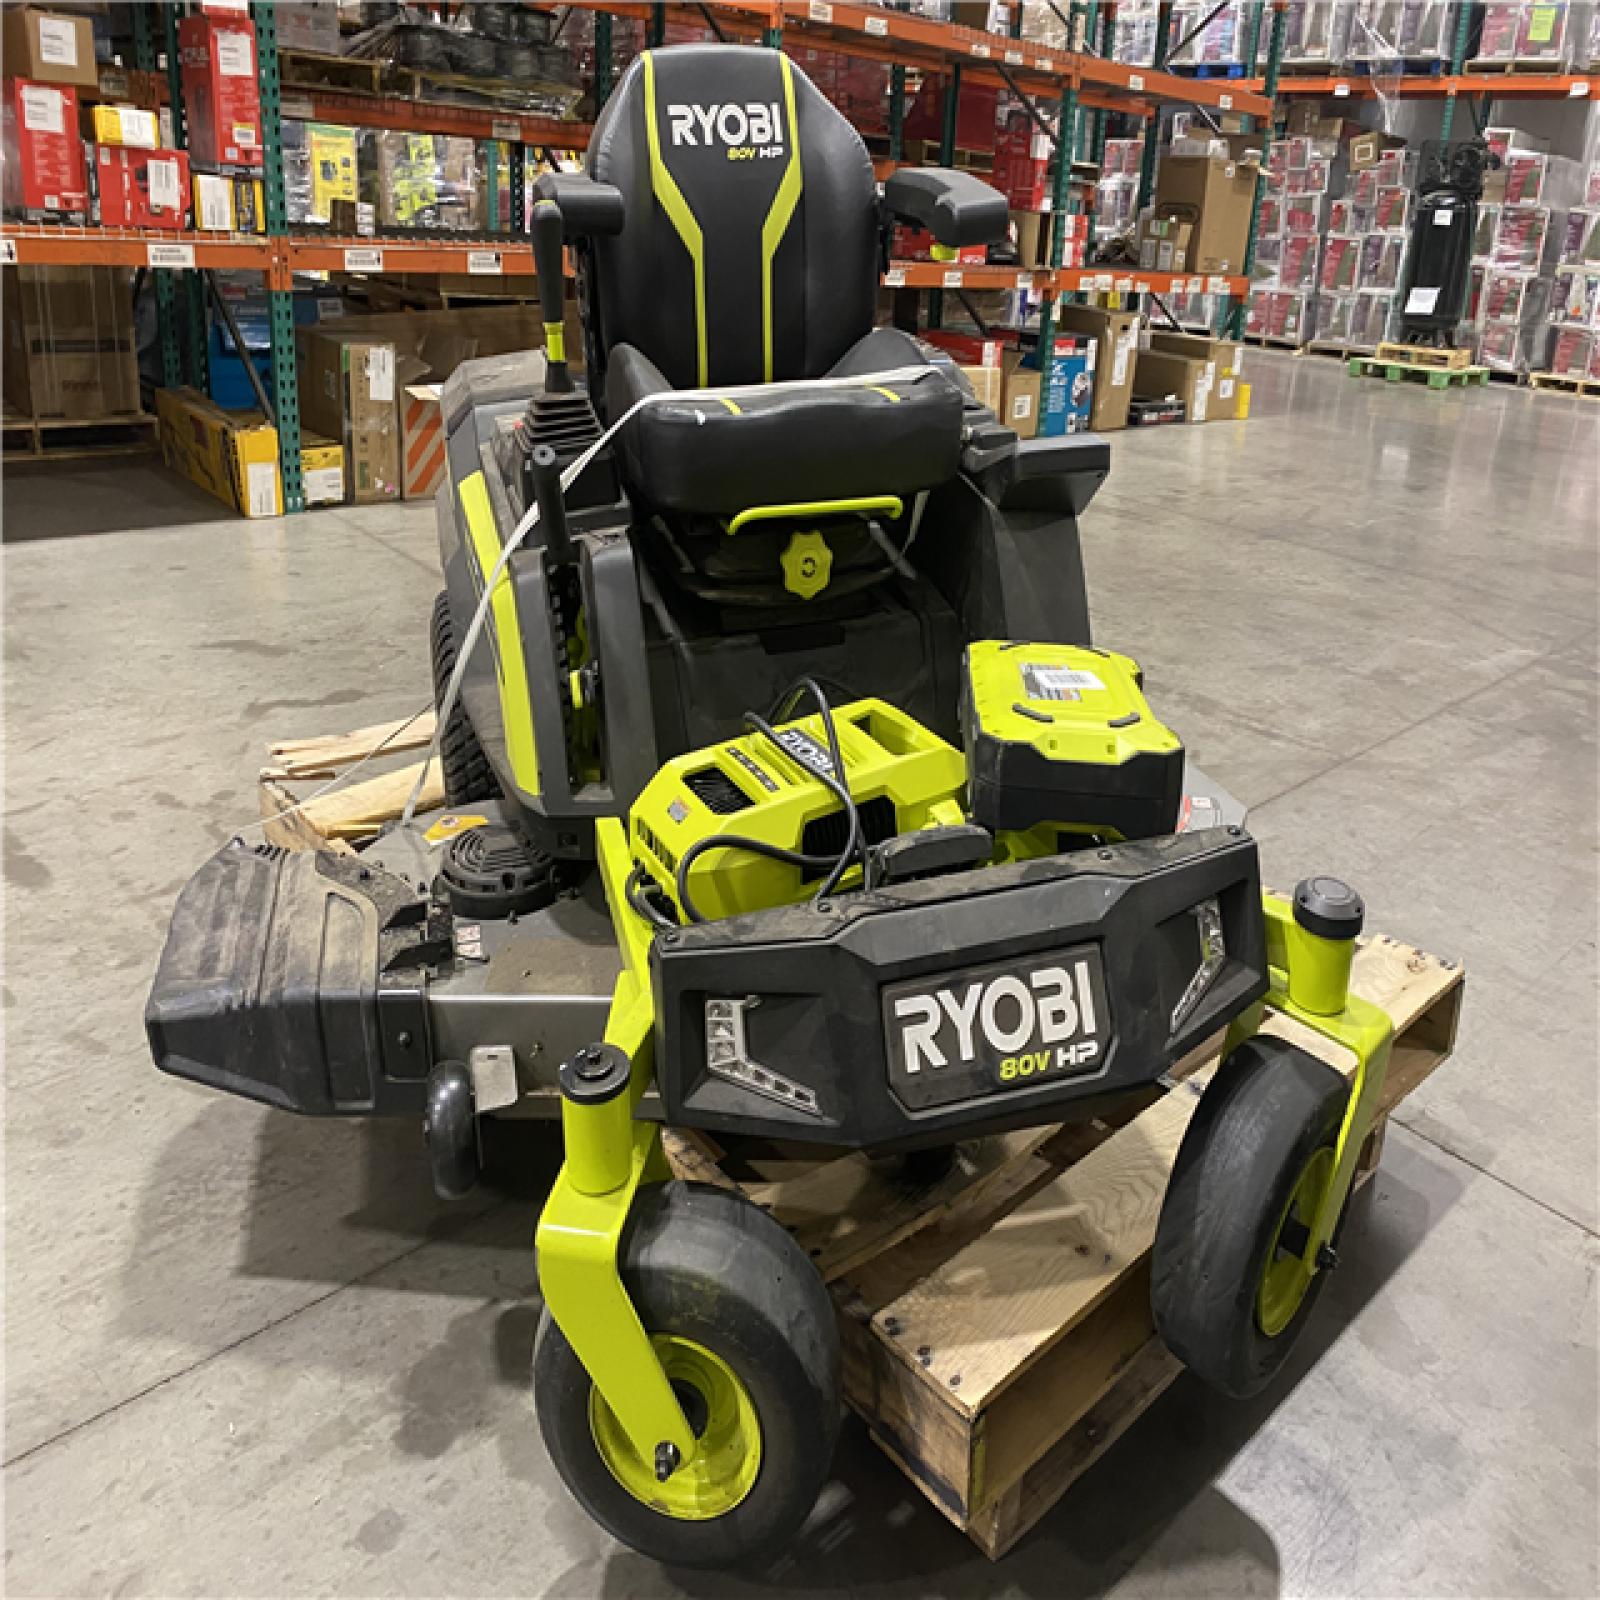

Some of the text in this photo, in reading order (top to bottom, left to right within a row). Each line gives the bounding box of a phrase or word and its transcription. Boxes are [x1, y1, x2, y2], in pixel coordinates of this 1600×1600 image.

[667, 102, 783, 146] RYOBI
[759, 146, 784, 158] HP
[894, 960, 1096, 1073] RYOBI
[999, 1039, 1099, 1081] 80V HP
